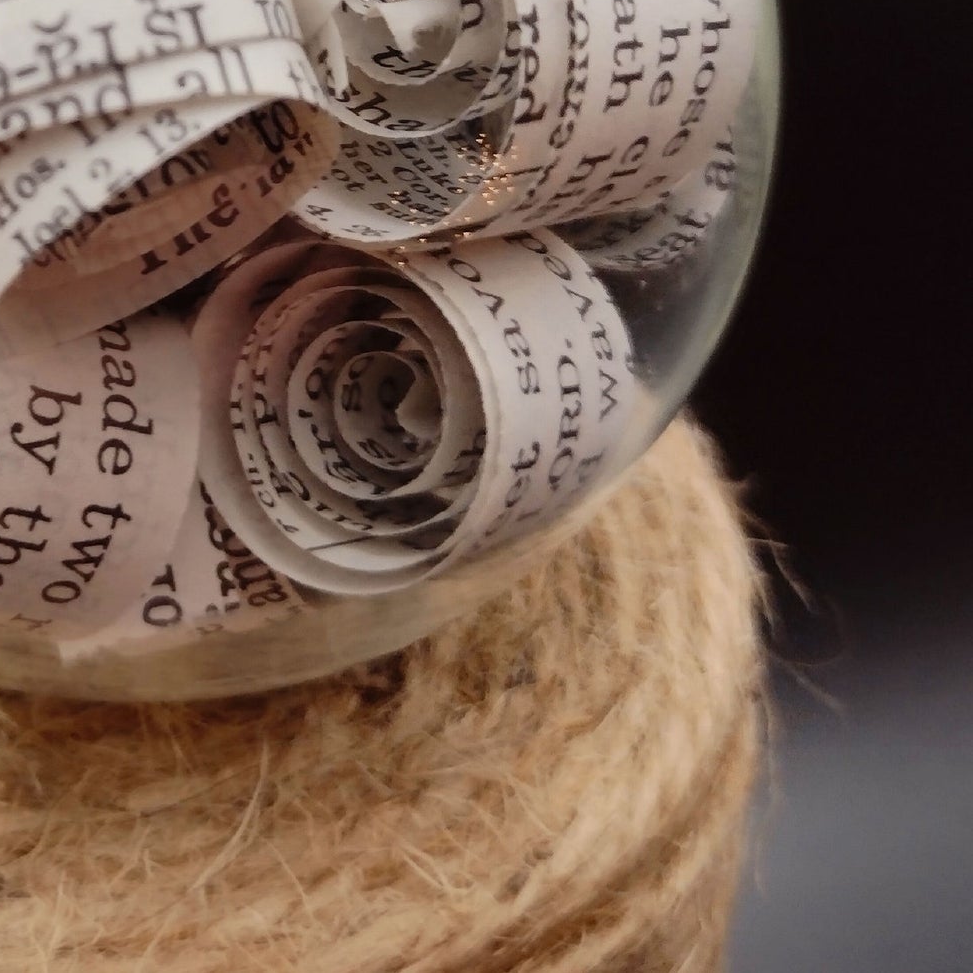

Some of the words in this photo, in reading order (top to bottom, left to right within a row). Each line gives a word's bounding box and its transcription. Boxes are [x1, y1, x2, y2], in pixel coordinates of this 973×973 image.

[648, 21, 691, 108] he
[10, 383, 84, 477] by
[41, 502, 133, 605] two
